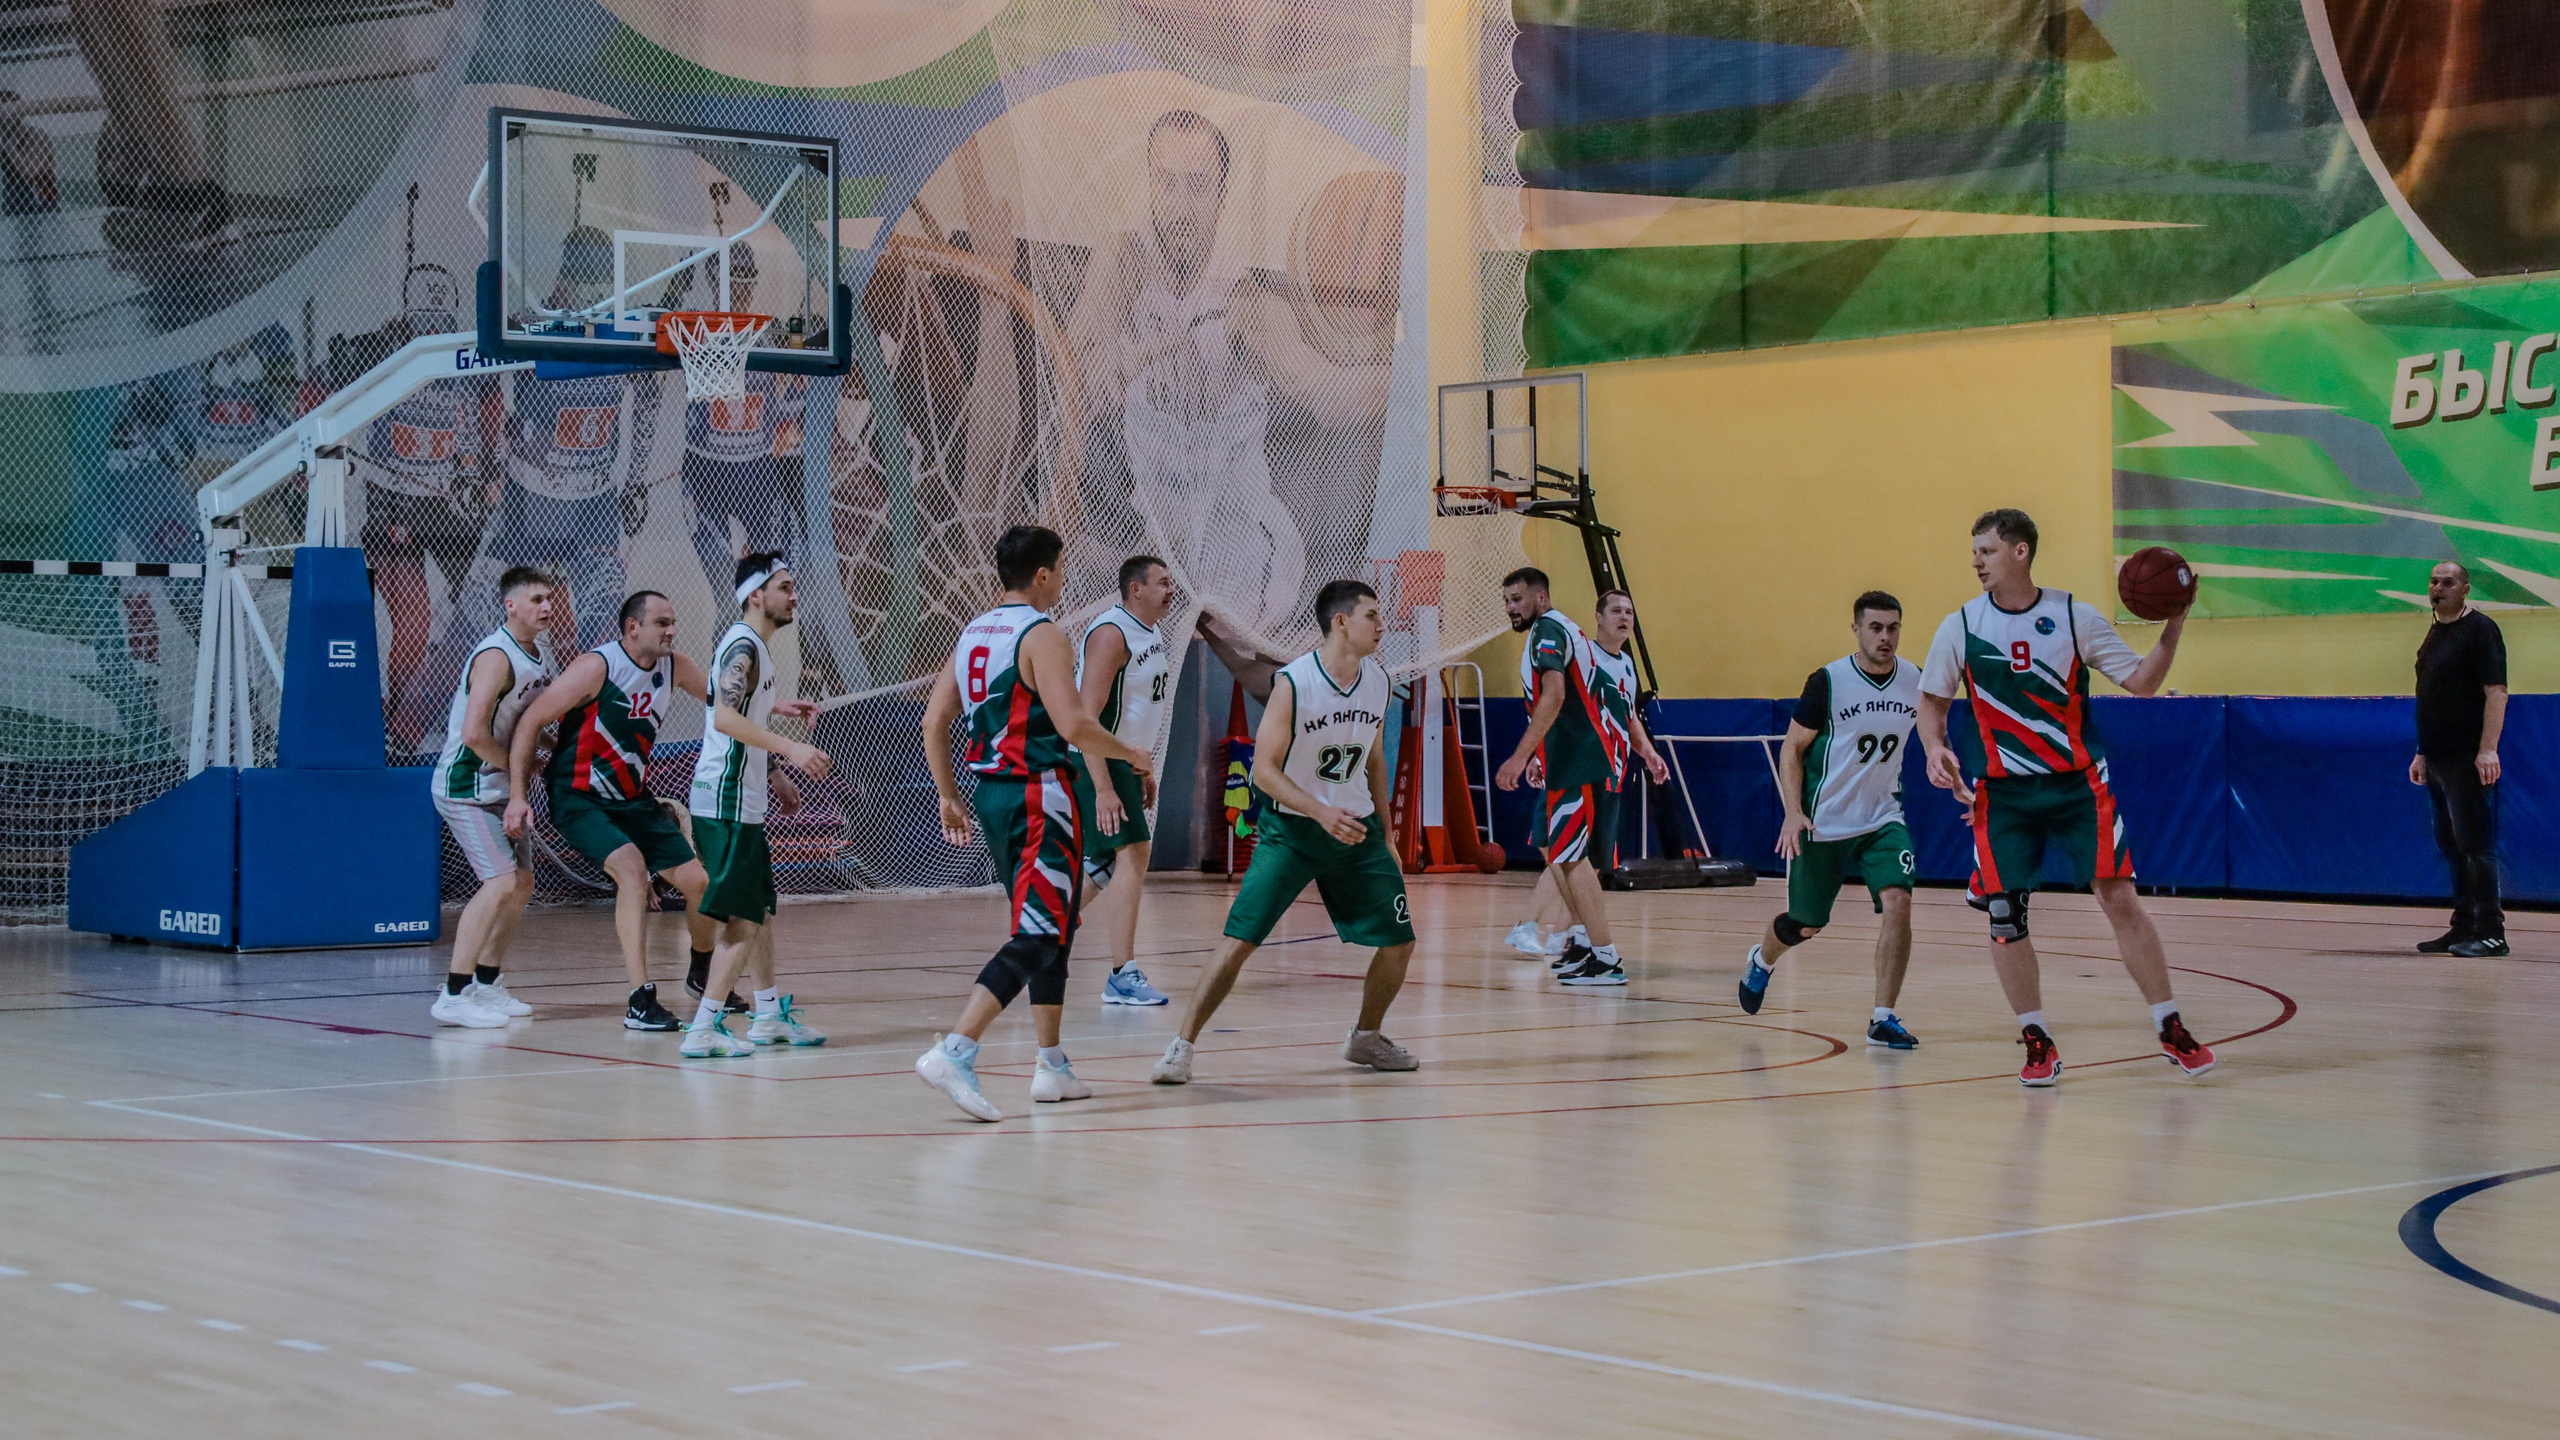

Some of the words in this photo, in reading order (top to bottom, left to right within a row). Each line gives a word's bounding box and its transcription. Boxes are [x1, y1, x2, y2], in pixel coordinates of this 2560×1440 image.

[2389, 331, 2560, 430] БЫС
[1136, 648, 1150, 667] НК
[2010, 640, 2032, 673] 9
[967, 645, 991, 704] 8
[627, 691, 653, 719] 12
[1840, 703, 1862, 721] НК
[1303, 714, 1329, 734] НК
[1857, 733, 1900, 764] 99
[1316, 743, 1366, 784] 27
[1898, 849, 1915, 875] 9
[158, 908, 222, 936] GARED
[374, 920, 430, 934] GARED
